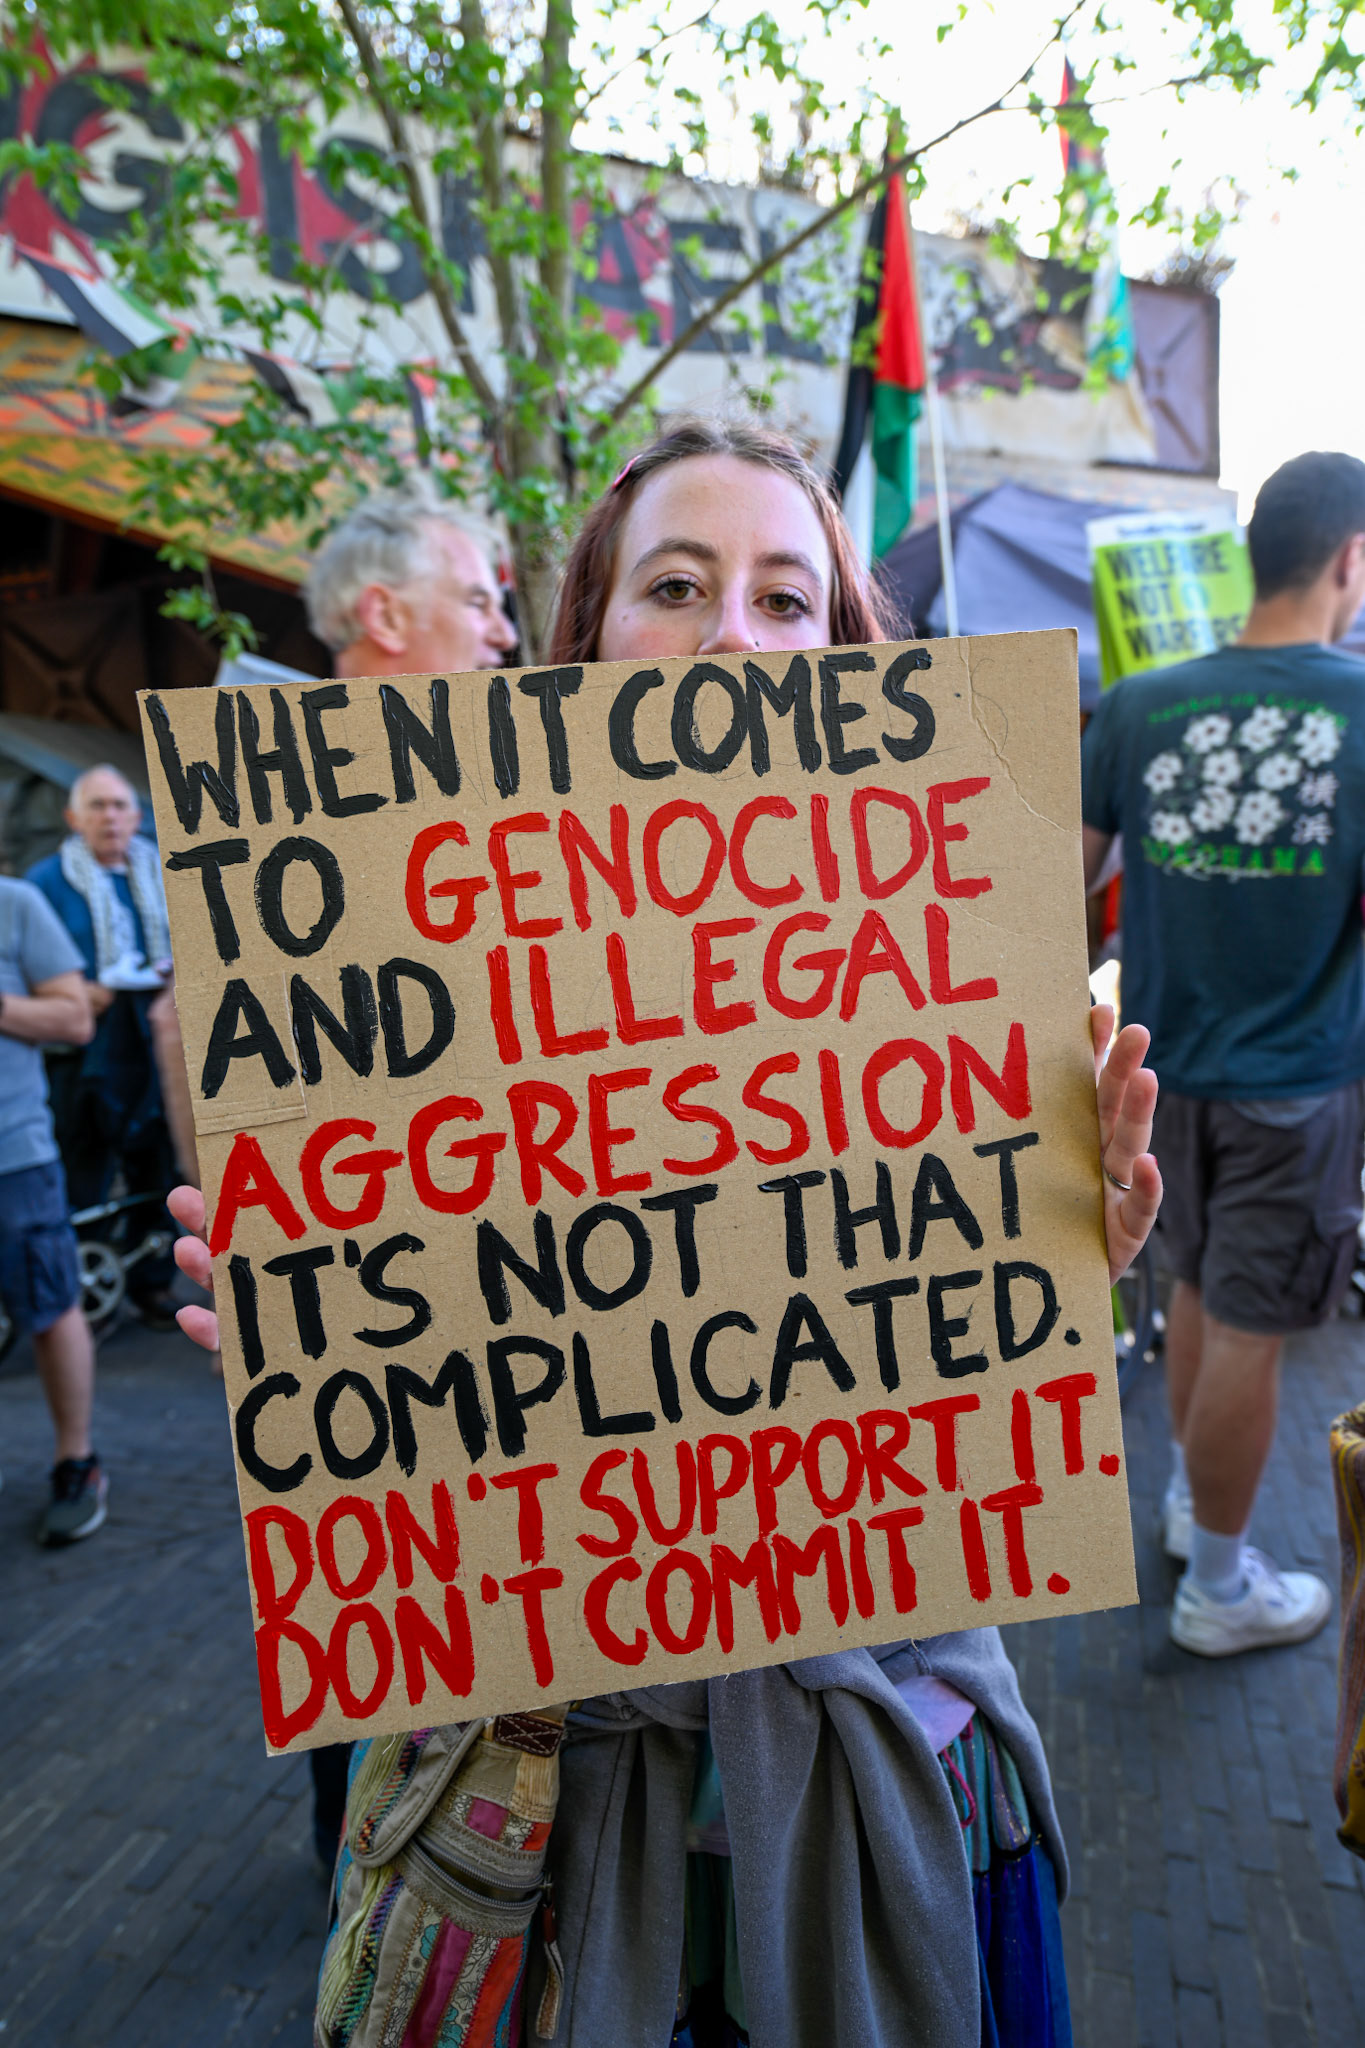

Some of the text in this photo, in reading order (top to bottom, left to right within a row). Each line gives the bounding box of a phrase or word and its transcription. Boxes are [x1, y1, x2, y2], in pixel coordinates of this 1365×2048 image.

[1105, 538, 1228, 581] WELFARE
[1117, 583, 1174, 618] NOT
[145, 648, 936, 835] WHEN IT COMES
[166, 777, 993, 967] TO GENOCIDE
[201, 903, 999, 1099] AND ILLEGAL
[210, 1022, 1033, 1257] AGGRESSION
[228, 1132, 1039, 1380] IT'S NOT THAT
[236, 1260, 1082, 1493] COMPLICATED.
[245, 1373, 1120, 1622] DON'T SUPPORT IT.
[255, 1483, 1070, 1749] DON'T COMMIT IT.
